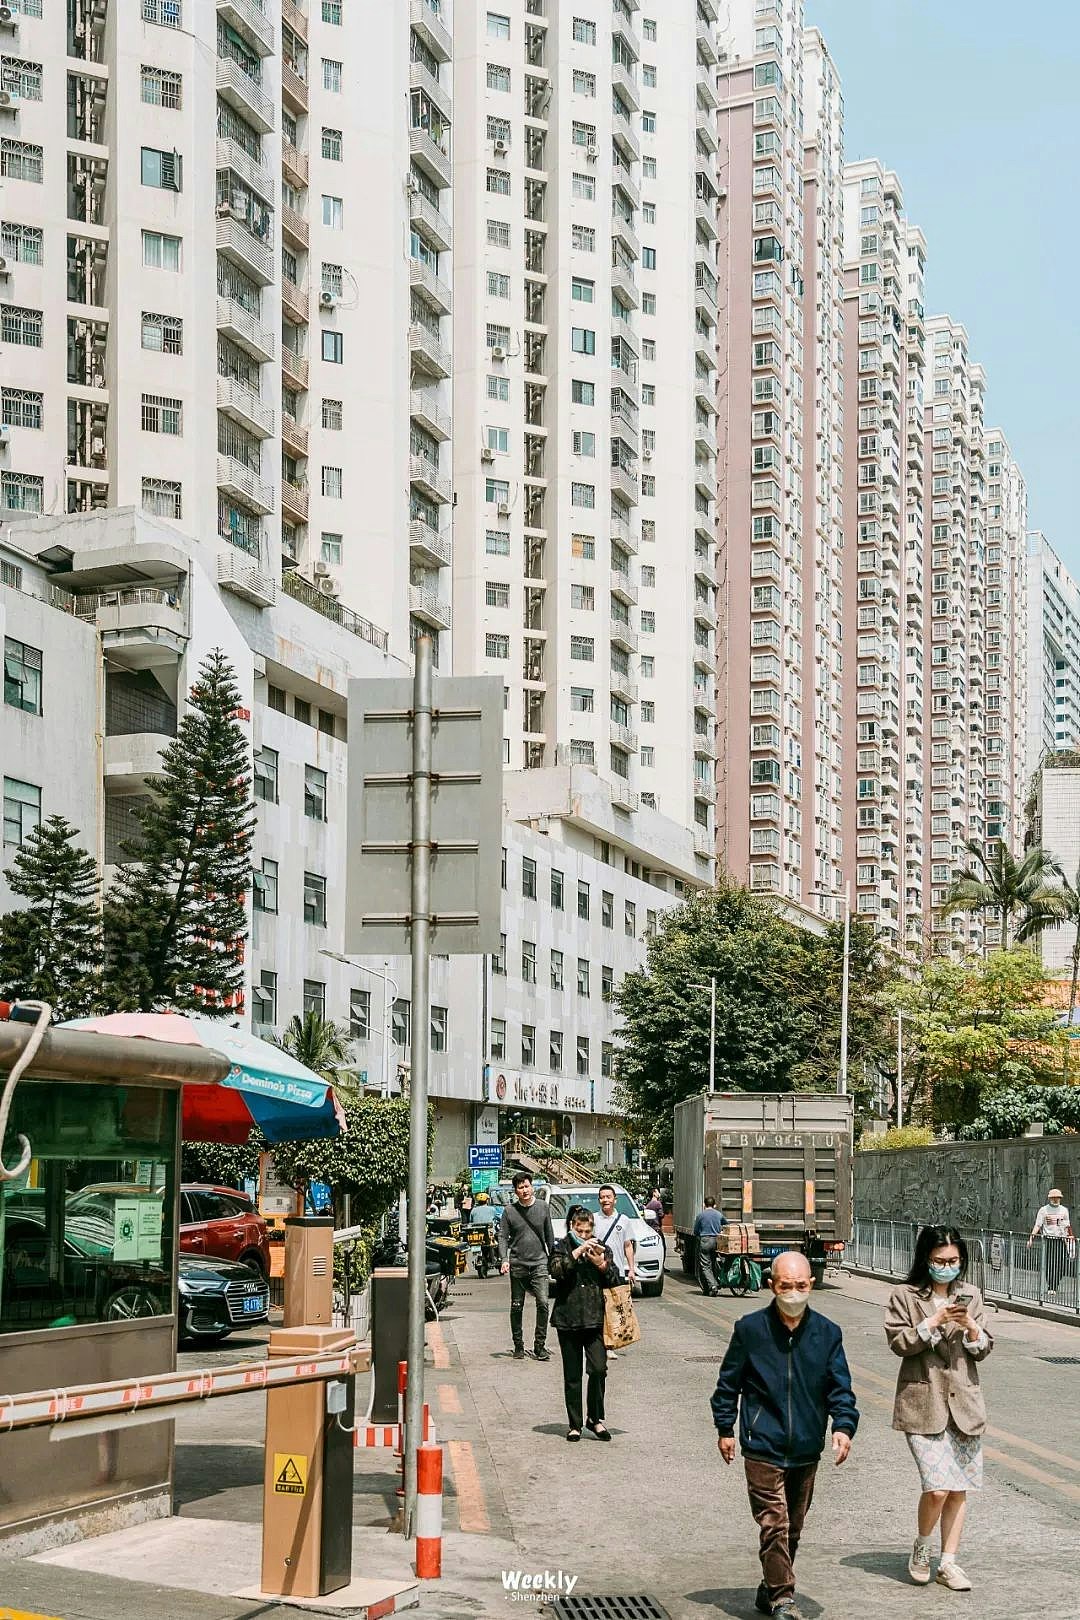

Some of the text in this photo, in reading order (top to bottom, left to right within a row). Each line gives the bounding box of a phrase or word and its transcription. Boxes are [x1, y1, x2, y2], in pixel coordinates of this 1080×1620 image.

[241, 1073, 285, 1092] Domino's
[470, 1147, 479, 1164] P
[474, 1169, 480, 1178] P
